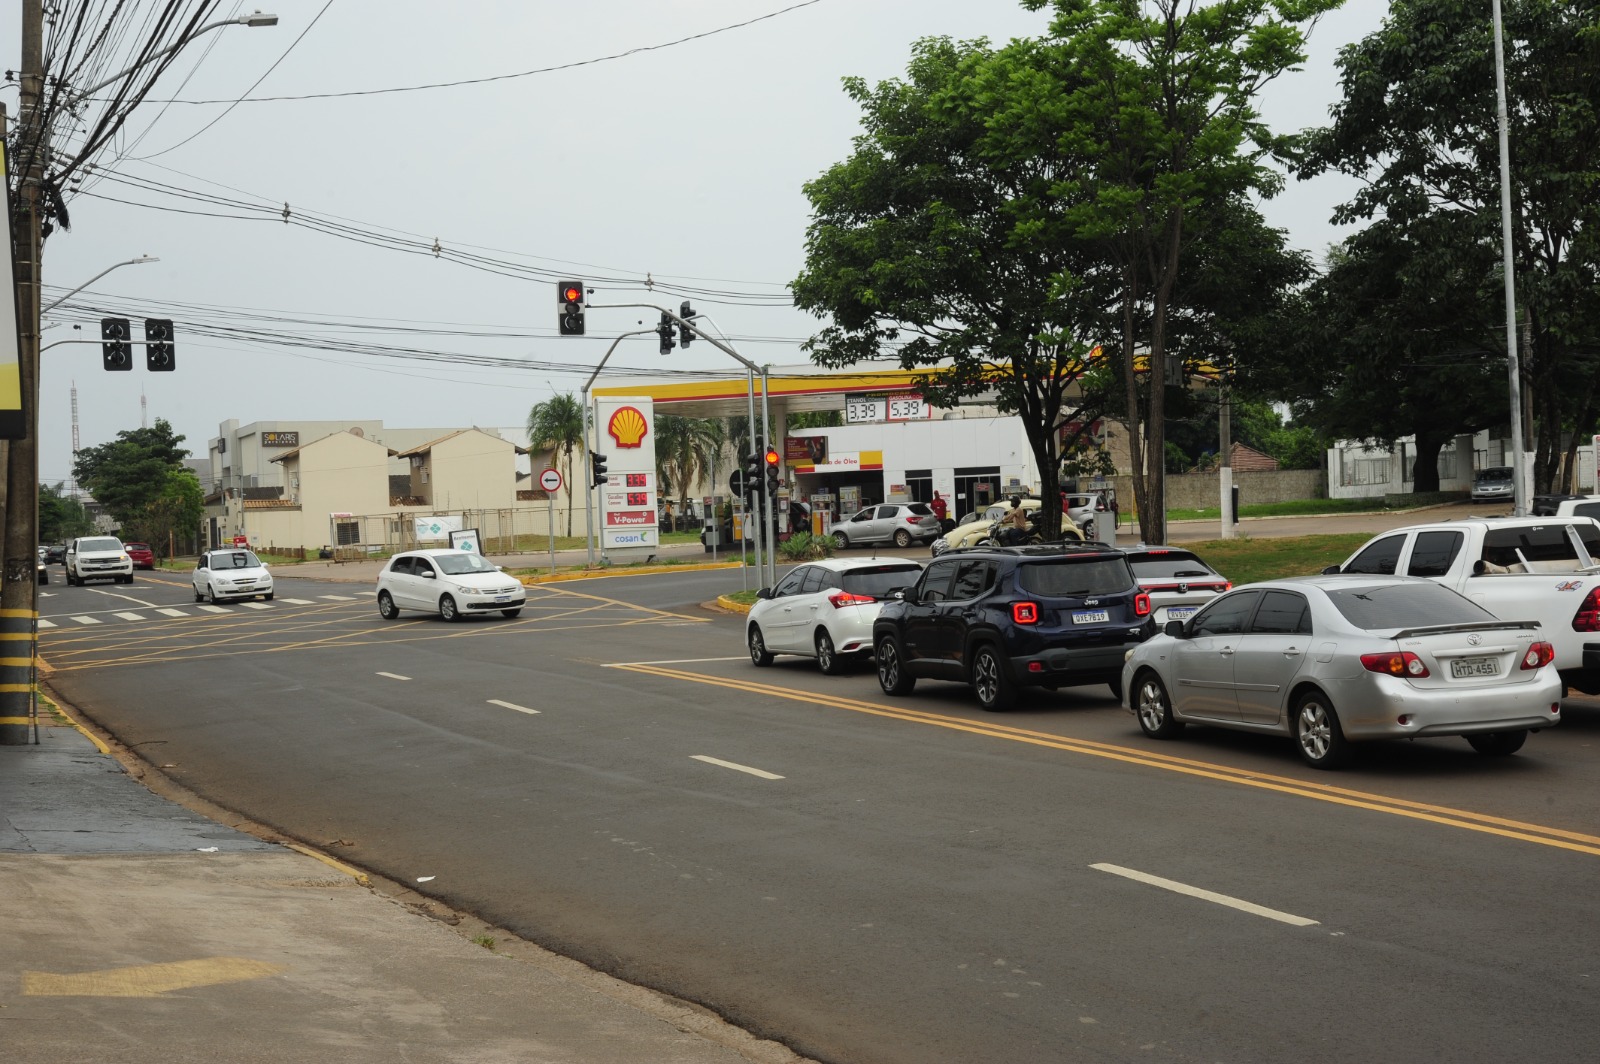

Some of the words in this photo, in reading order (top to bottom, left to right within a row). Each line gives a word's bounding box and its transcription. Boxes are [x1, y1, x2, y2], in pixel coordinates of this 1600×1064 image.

[850, 403, 876, 420] 3,39
[891, 401, 919, 417] 5,39
[614, 516, 646, 524] V-Power
[615, 535, 639, 543] cosan
